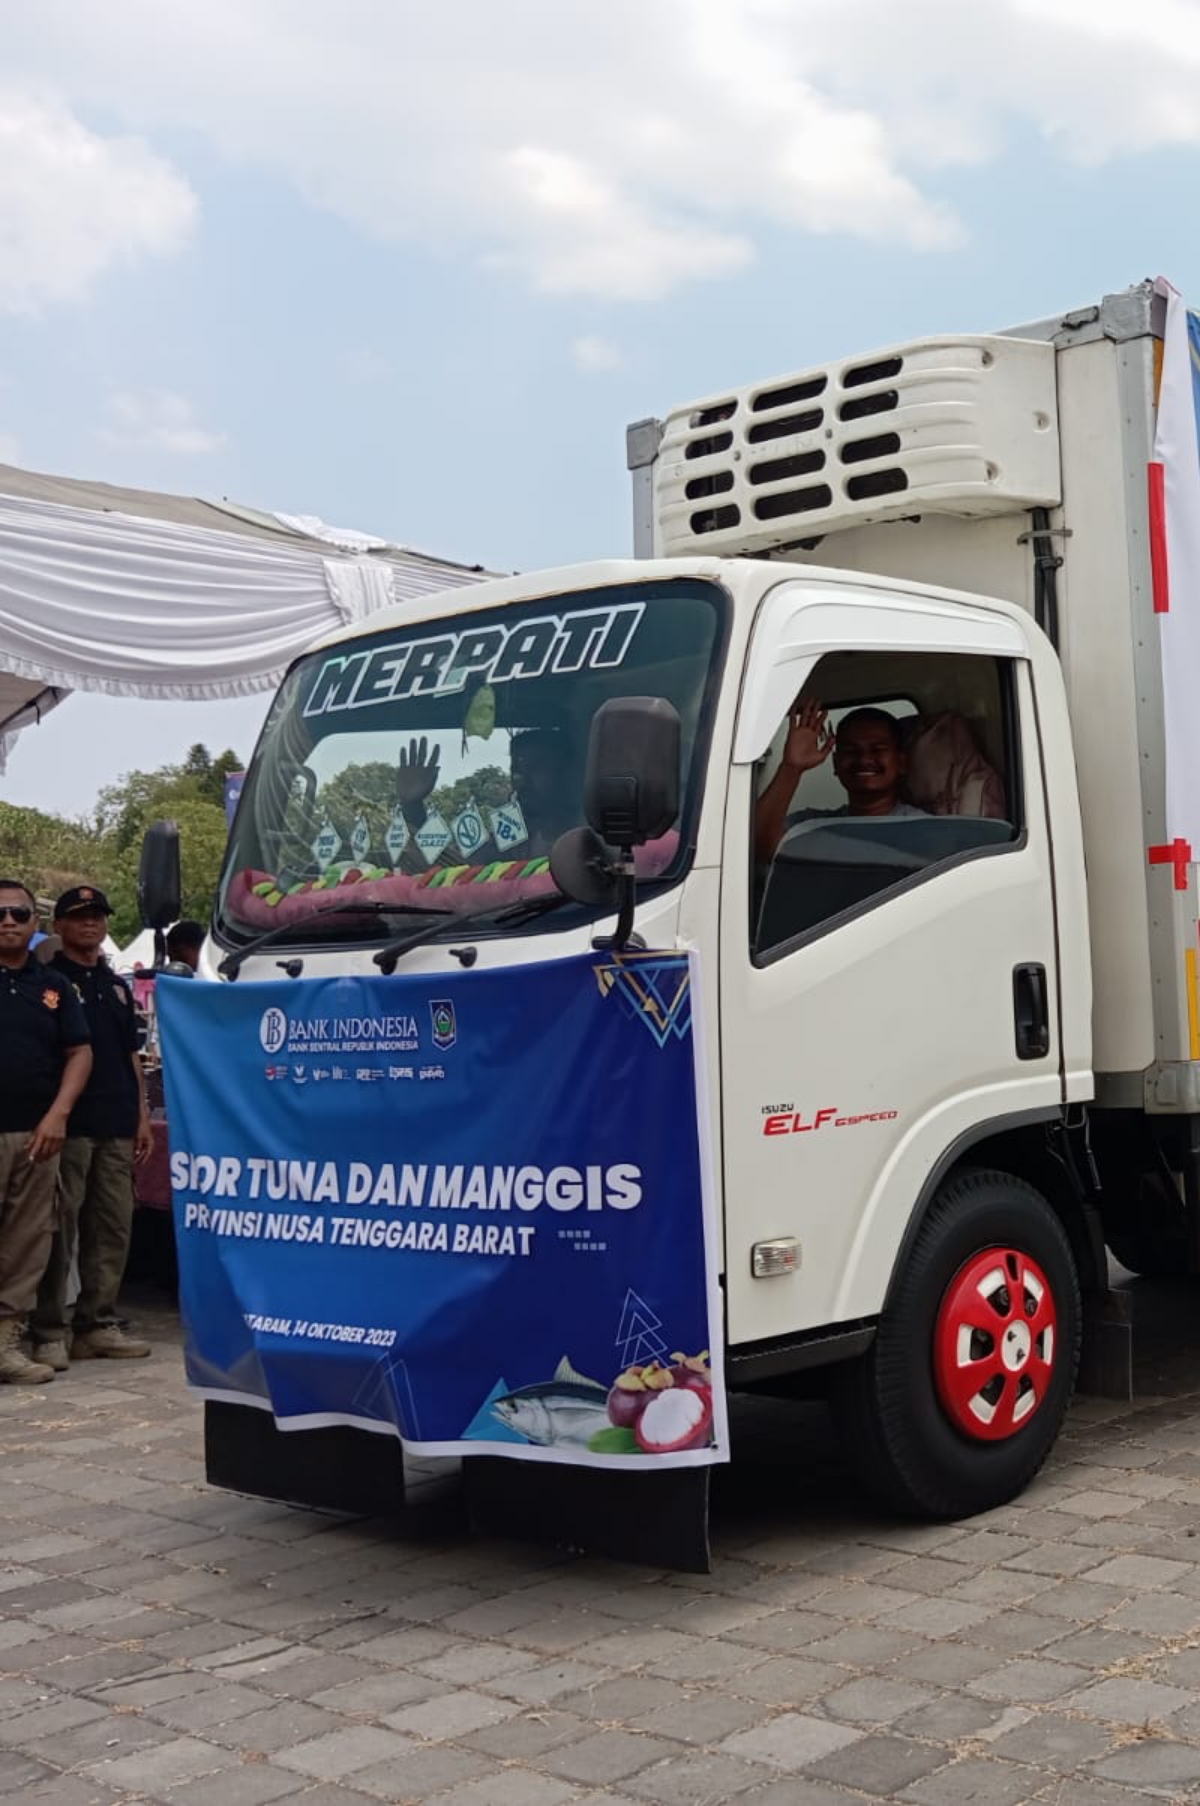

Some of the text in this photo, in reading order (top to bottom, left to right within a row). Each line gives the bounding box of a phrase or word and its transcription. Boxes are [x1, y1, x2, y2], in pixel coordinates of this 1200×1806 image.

[303, 601, 647, 718] MERPATI
[289, 1016, 418, 1040] BANK INDONESIA
[376, 1040, 419, 1051] INDONESIA
[762, 1103, 794, 1114] ISUZU
[763, 1108, 838, 1136] ELF
[247, 1158, 340, 1203] TUNA
[346, 1161, 427, 1208] DAN
[429, 1163, 643, 1211] MANGGIS
[265, 1213, 324, 1243] NUSA
[330, 1217, 448, 1251] TENGGARA
[452, 1223, 535, 1256] BARAT
[293, 1319, 308, 1338] 14
[307, 1322, 365, 1344] OKTOBER
[363, 1328, 398, 1347] 2023
